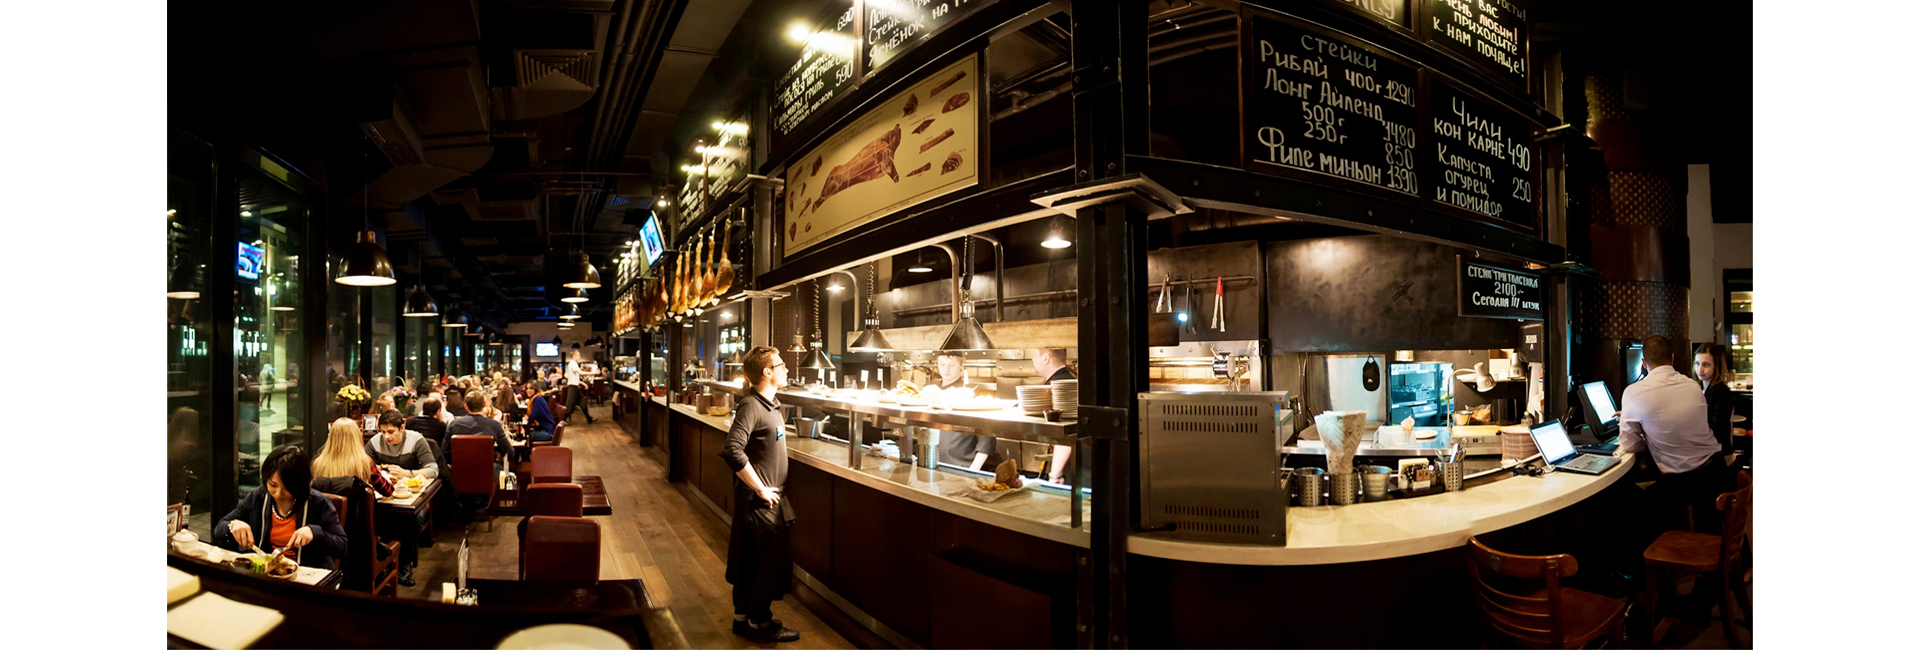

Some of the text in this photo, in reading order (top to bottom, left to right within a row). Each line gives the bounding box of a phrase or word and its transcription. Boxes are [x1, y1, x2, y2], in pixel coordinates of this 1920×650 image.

[837, 6, 854, 31] 690
[835, 60, 854, 87] 590
[1383, 79, 1415, 108] 1290
[1452, 96, 1502, 141] Чили
[1383, 121, 1416, 149] 1480
[1385, 142, 1414, 170] 850
[1508, 137, 1530, 172] 490
[1387, 165, 1418, 195] 1390
[1512, 176, 1531, 203] 250
